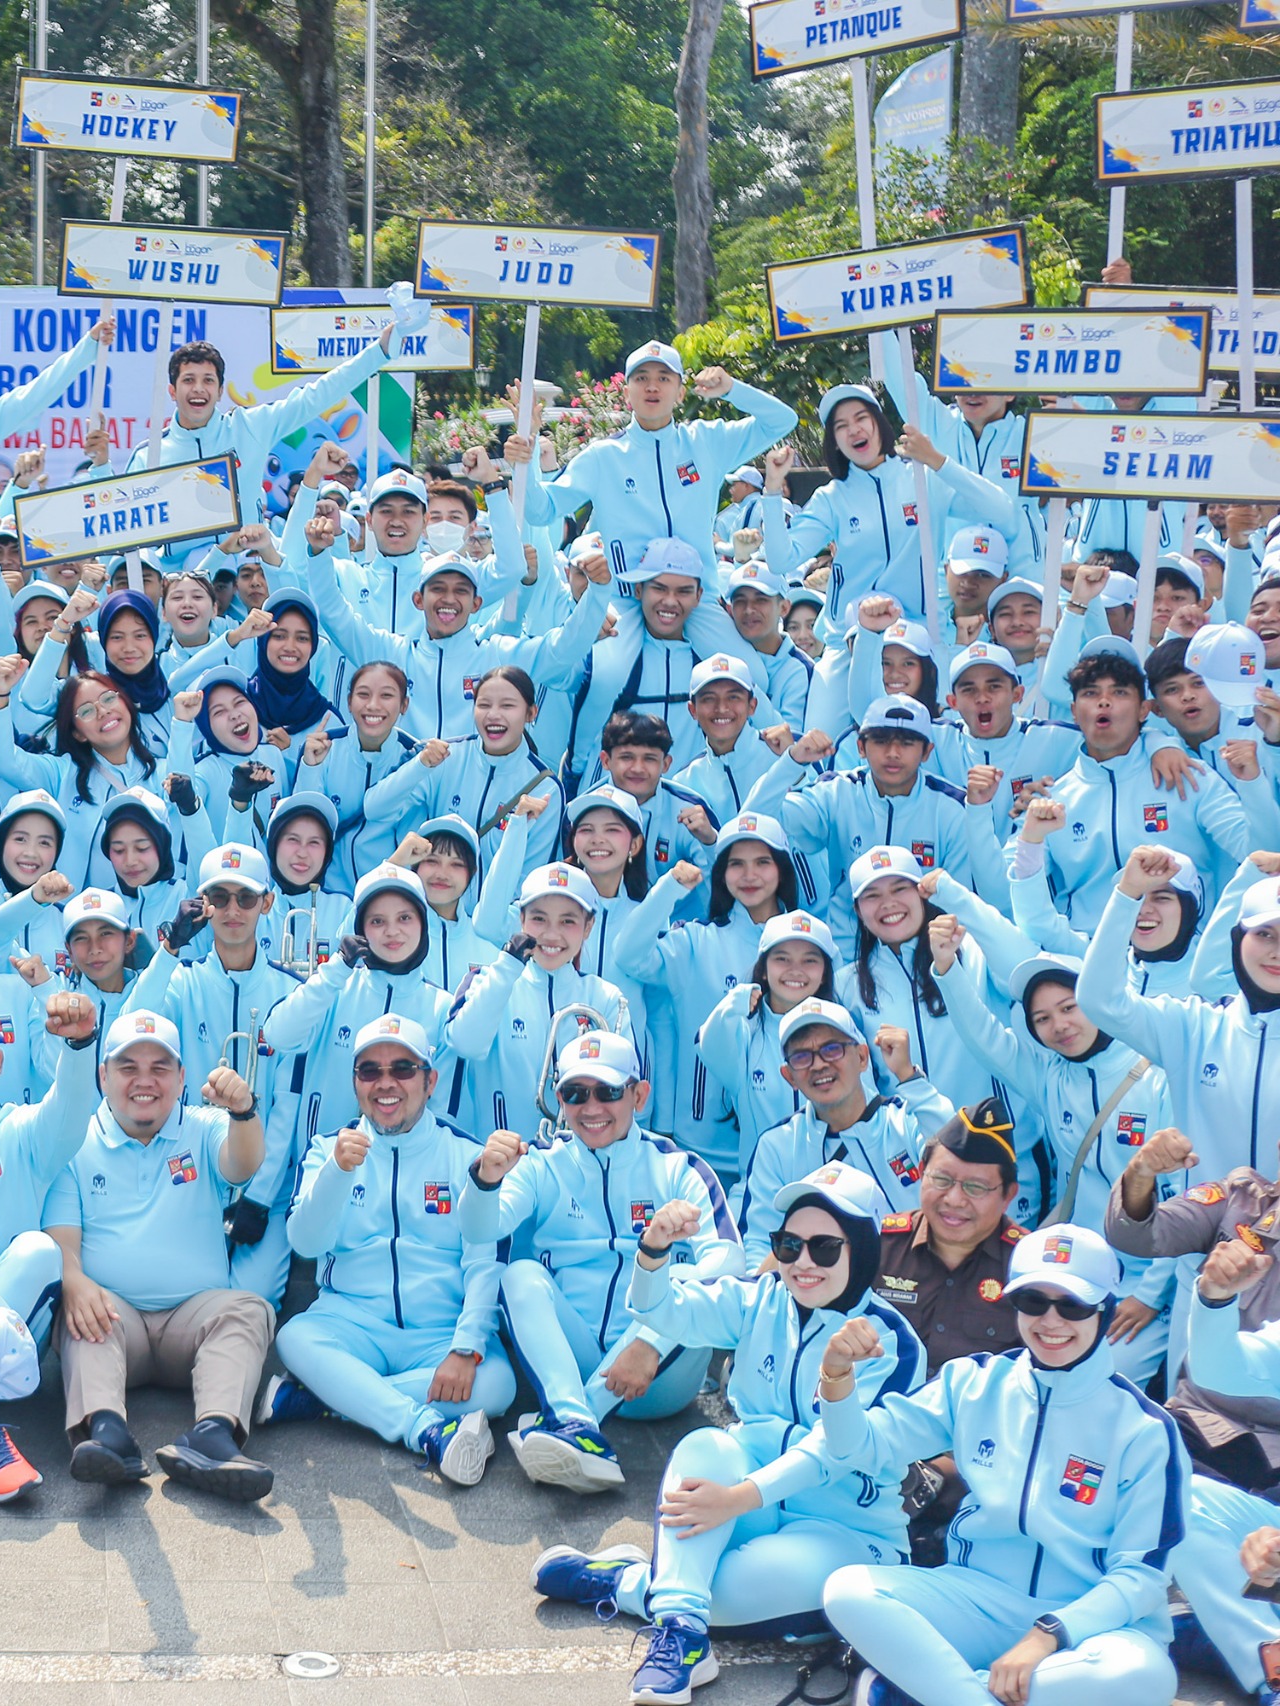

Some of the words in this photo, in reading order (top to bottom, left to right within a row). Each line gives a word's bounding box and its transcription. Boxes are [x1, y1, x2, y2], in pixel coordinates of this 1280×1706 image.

[805, 5, 902, 48] PETANQUE
[81, 113, 178, 142] HOCKEY
[128, 258, 220, 286] WUSHU
[499, 260, 574, 286] JUDO
[841, 274, 954, 314] KURASH
[317, 335, 428, 358] MENEAK
[1014, 349, 1121, 374] SAMBO
[51, 417, 137, 449] BAAT
[1102, 451, 1214, 479] SELAM
[82, 501, 170, 538] KARATE
[567, 1213, 584, 1221] MILLS
[757, 1368, 773, 1383] MILLS
[972, 1459, 993, 1469] MILLS
